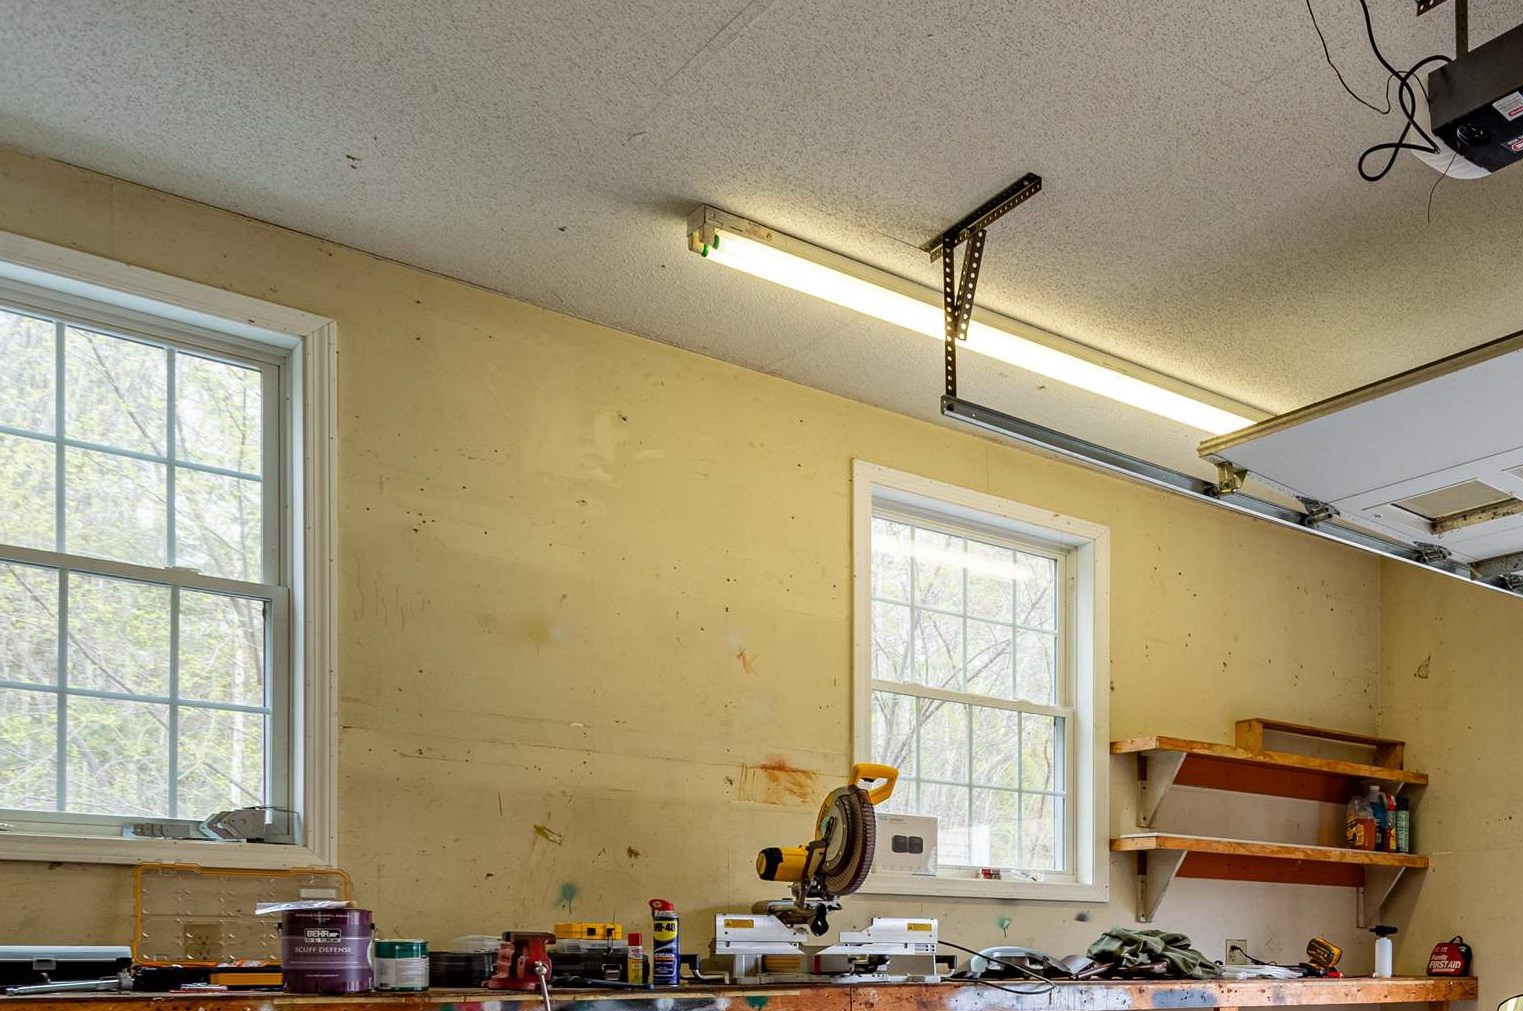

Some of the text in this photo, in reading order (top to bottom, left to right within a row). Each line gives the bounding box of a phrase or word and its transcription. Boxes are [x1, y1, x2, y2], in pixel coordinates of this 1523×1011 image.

[306, 930, 330, 938] BEHR
[1429, 960, 1462, 969] FIRST AID
